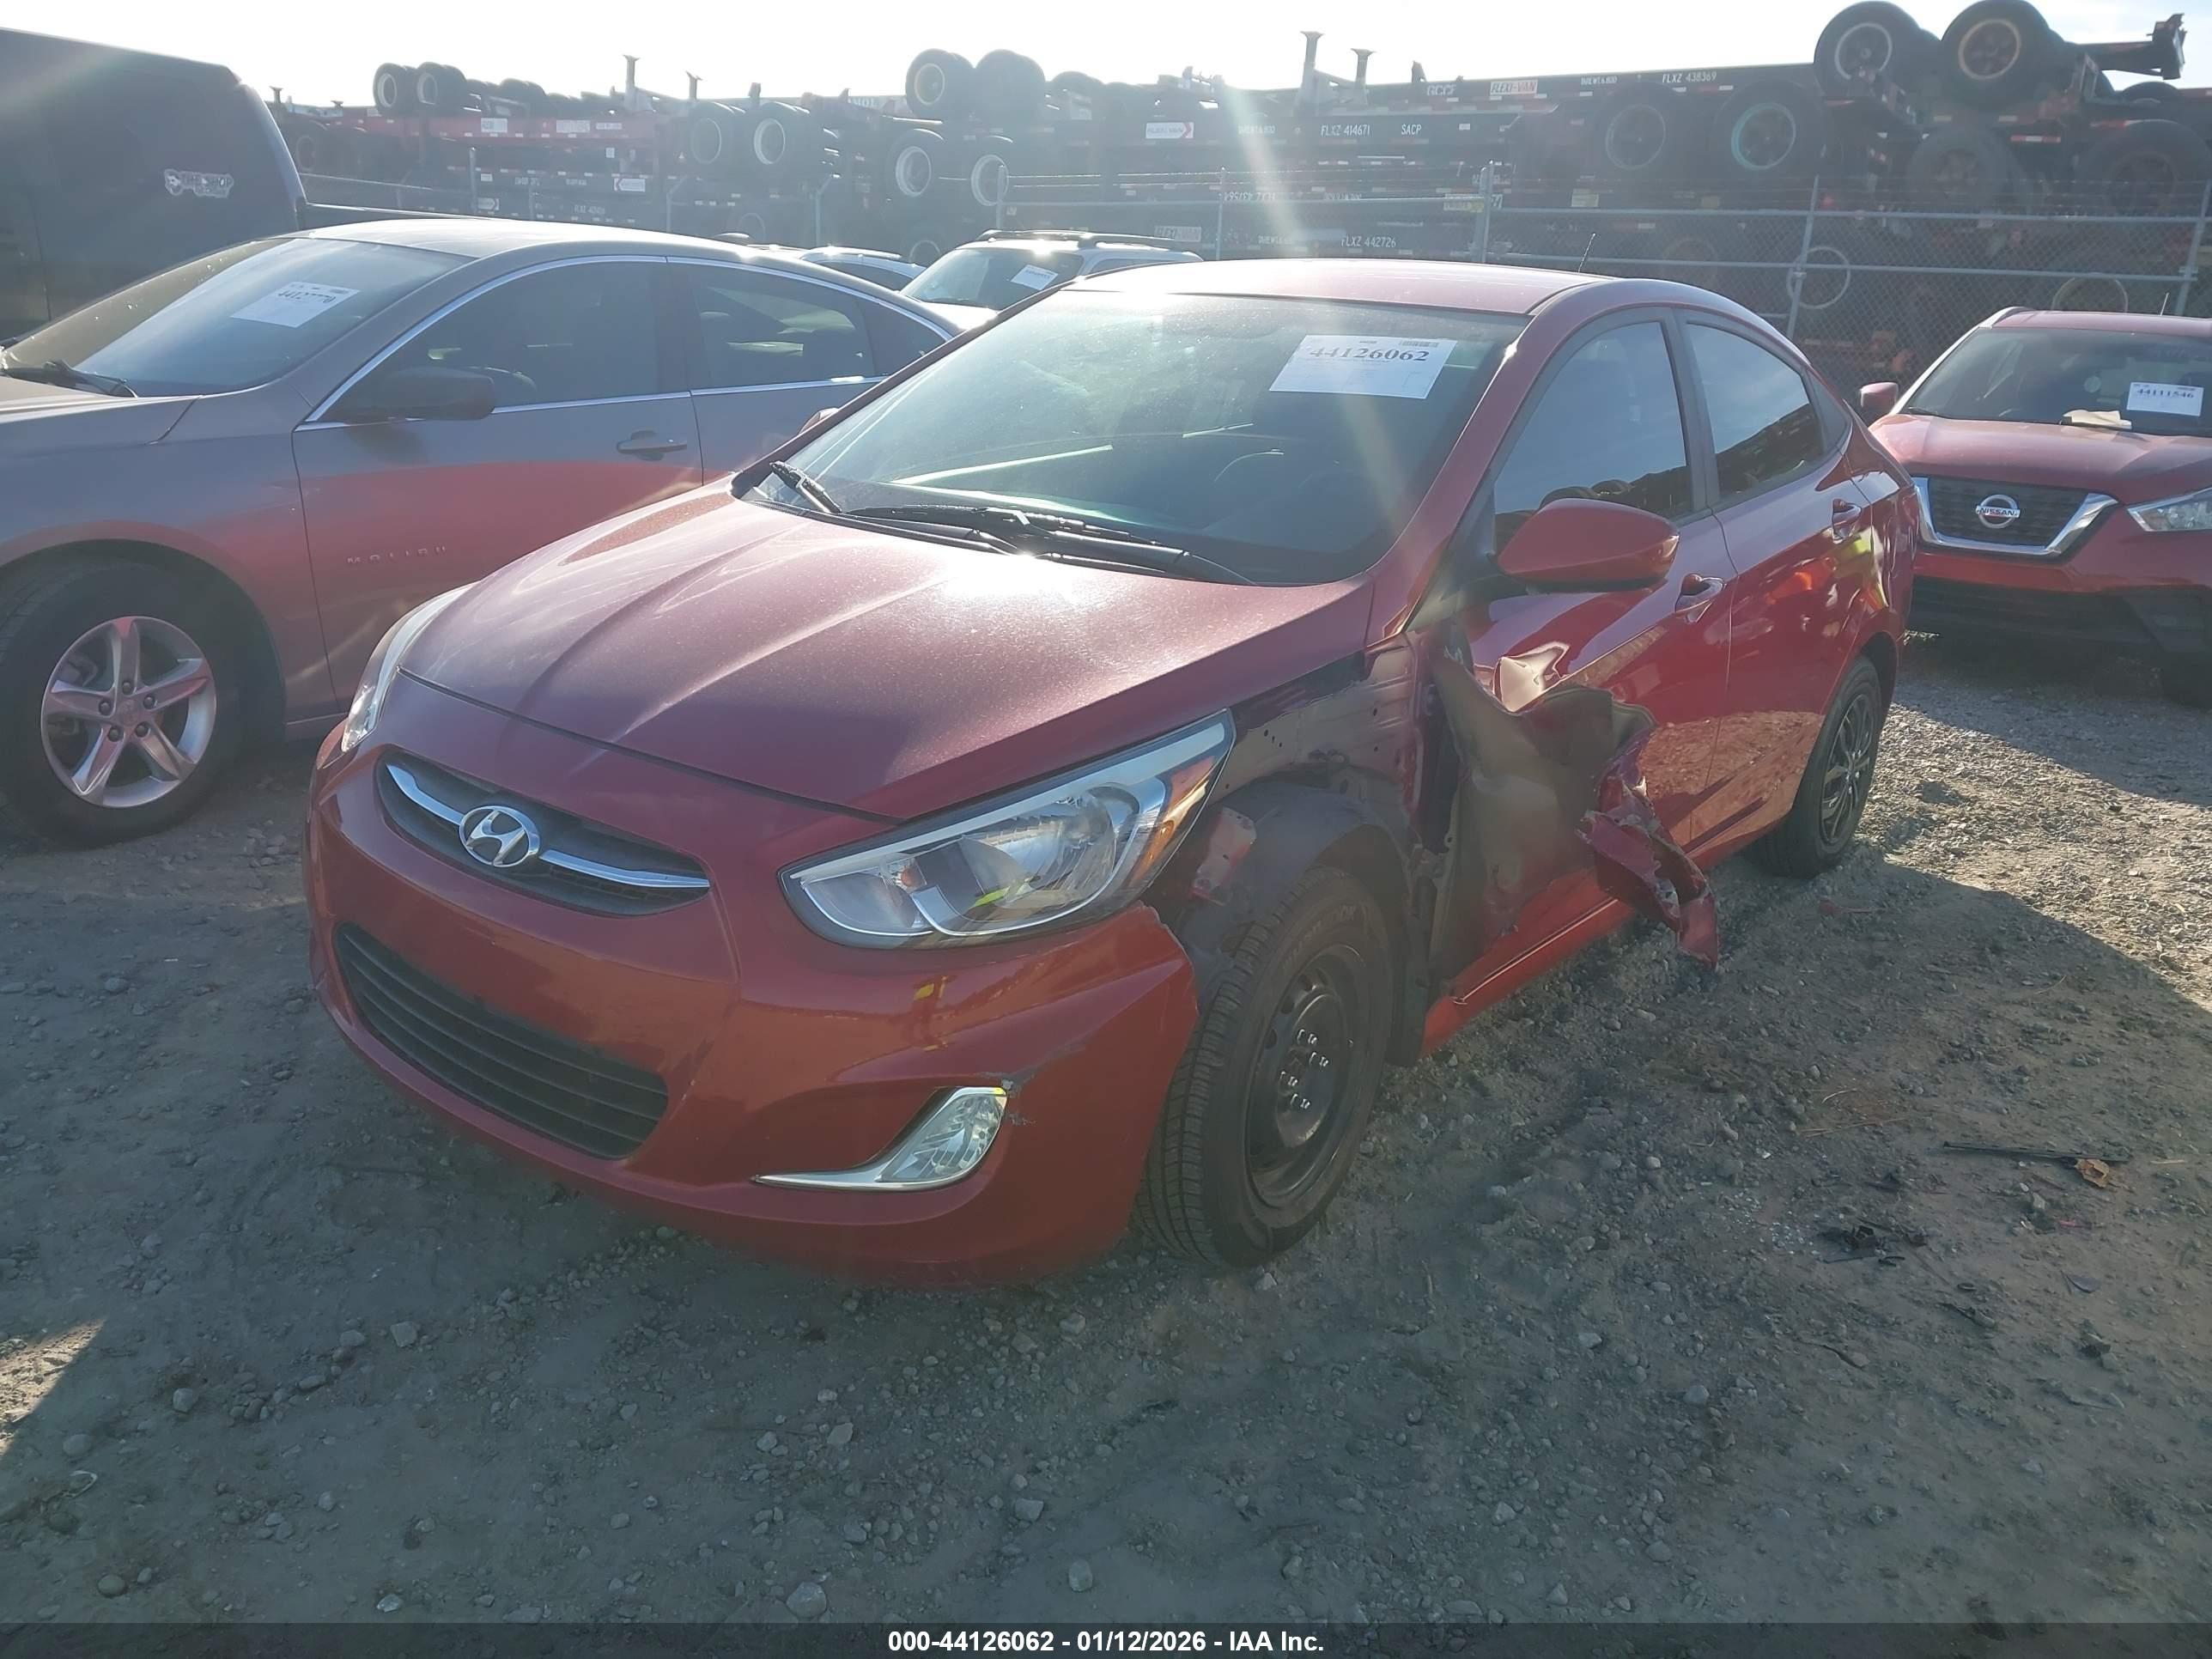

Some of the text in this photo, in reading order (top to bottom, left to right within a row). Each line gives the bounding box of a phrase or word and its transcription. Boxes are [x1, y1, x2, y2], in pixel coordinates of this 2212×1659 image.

[1662, 73, 1683, 83] FLXZ
[1321, 123, 1370, 137] FLXZ 414671
[1401, 124, 1422, 135] SACP
[1364, 236, 1396, 248] 442726
[1310, 347, 1430, 362] 44126062
[2136, 388, 2194, 398] 44111546
[1979, 507, 2015, 516] NISSAN
